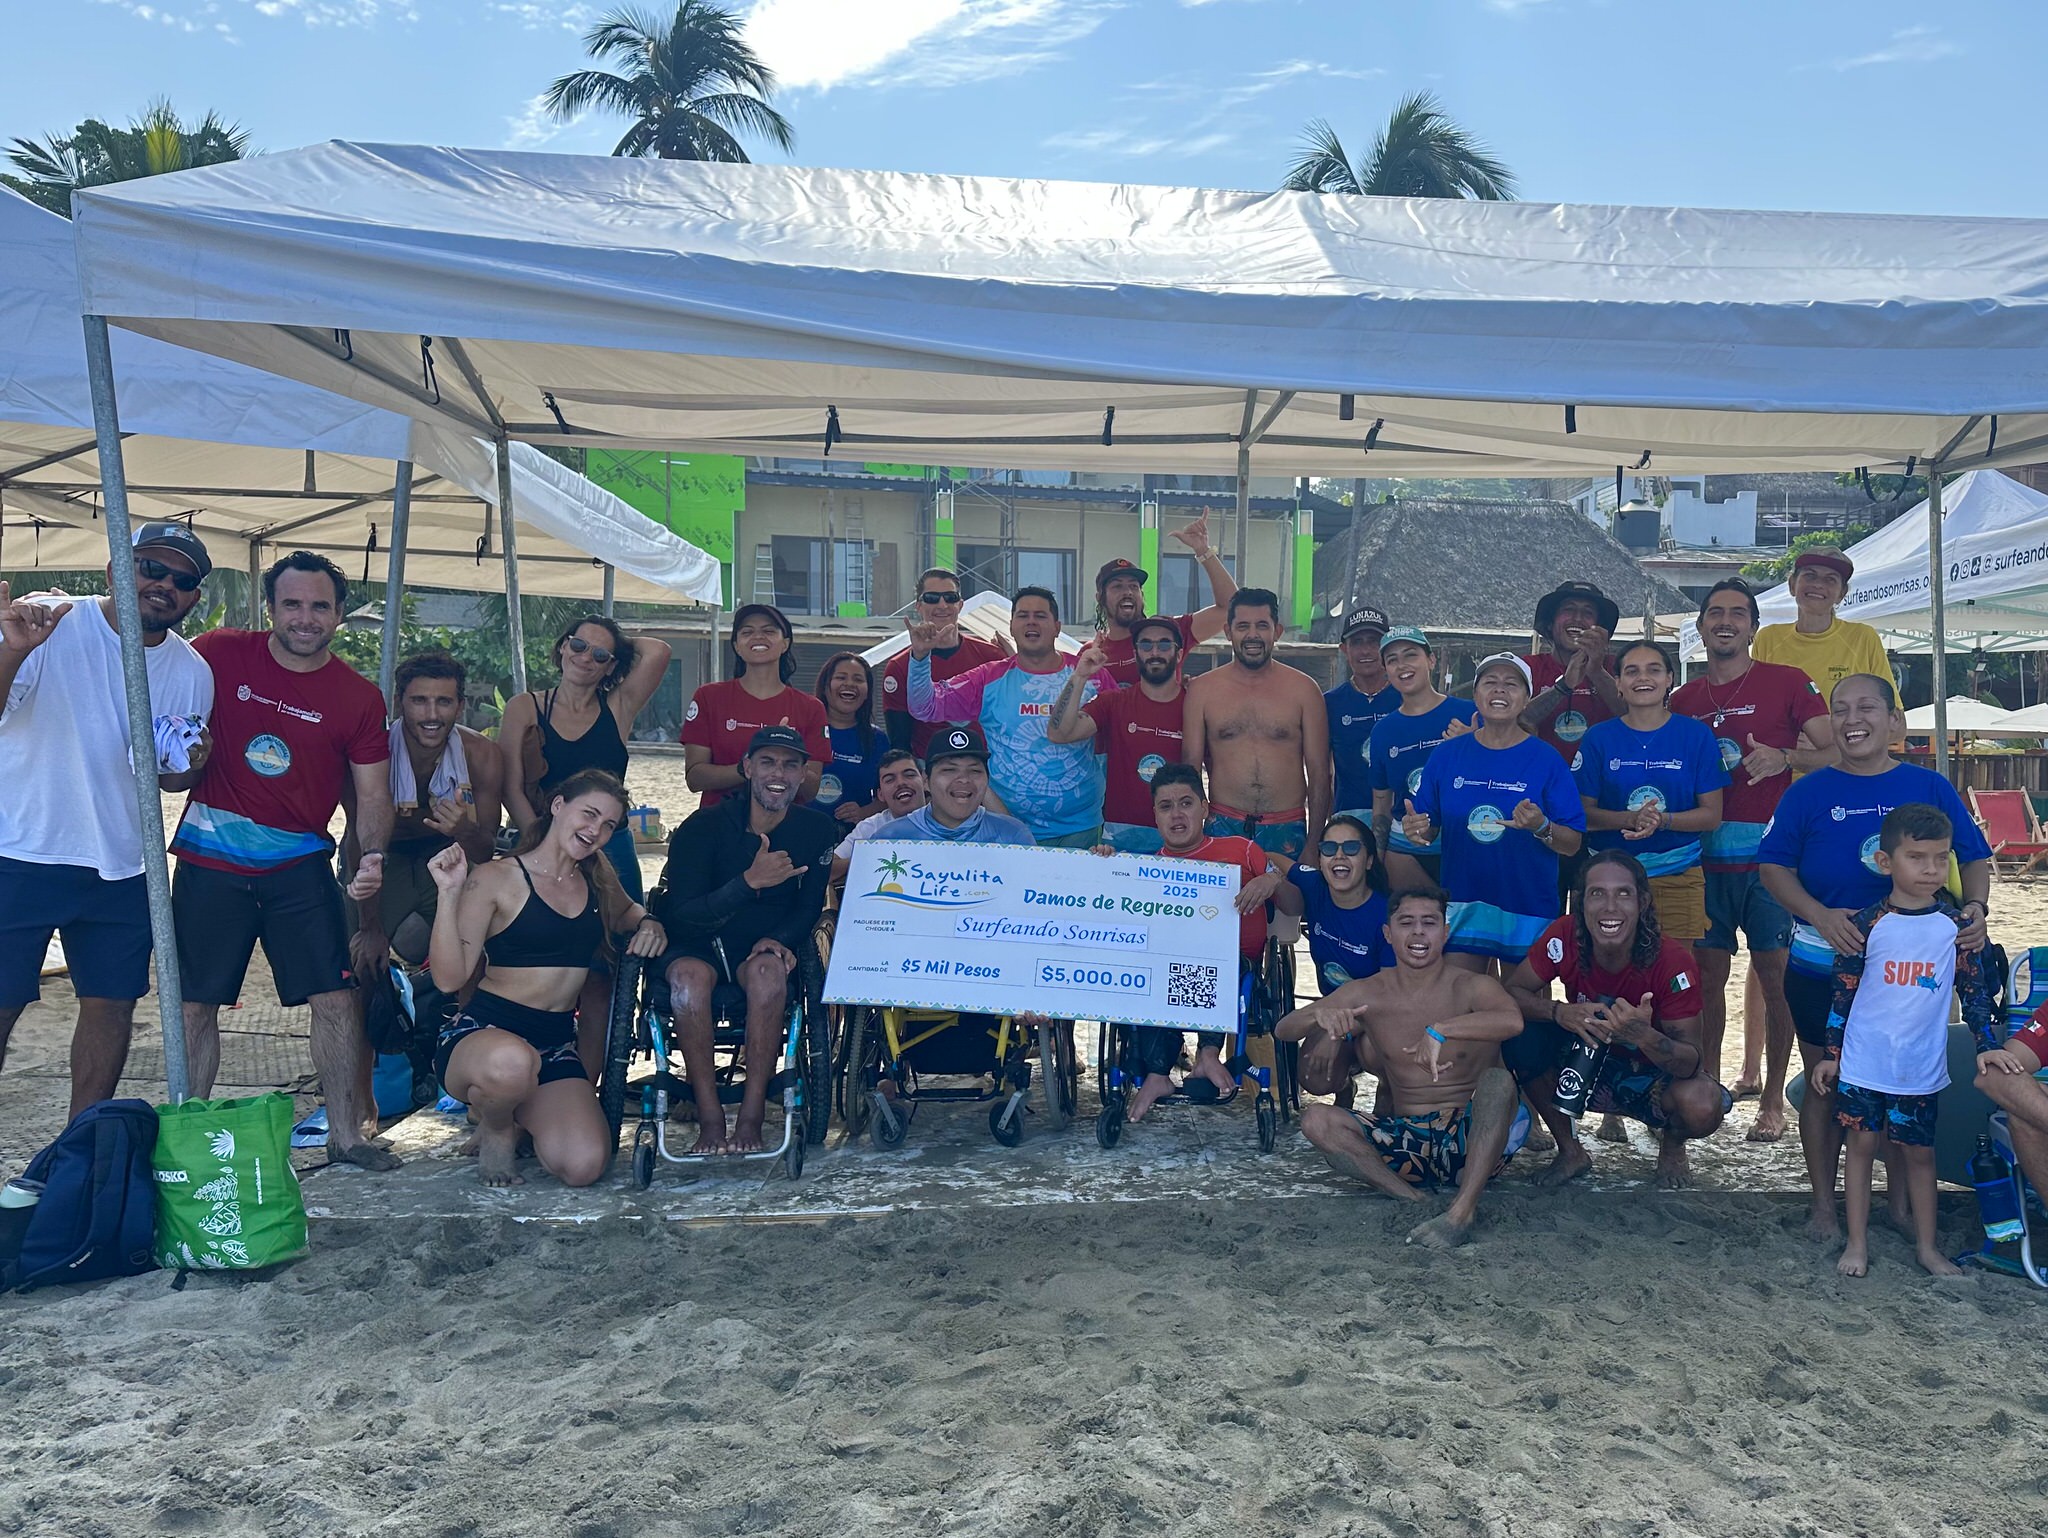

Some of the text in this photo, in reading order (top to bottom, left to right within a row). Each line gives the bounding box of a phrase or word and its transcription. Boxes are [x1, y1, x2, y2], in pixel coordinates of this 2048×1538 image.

[911, 863, 1003, 885] Sayulita
[1138, 866, 1227, 887] NOVIEMBRE
[1163, 885, 1198, 898] 2025
[1023, 888, 1195, 918] Damos de Regreso
[956, 917, 1146, 944] Surfeando Sonrisas
[901, 958, 1001, 978] $5 Mil Pesos
[1041, 965, 1146, 988] $5,000.00
[1884, 961, 1935, 986] SURF
